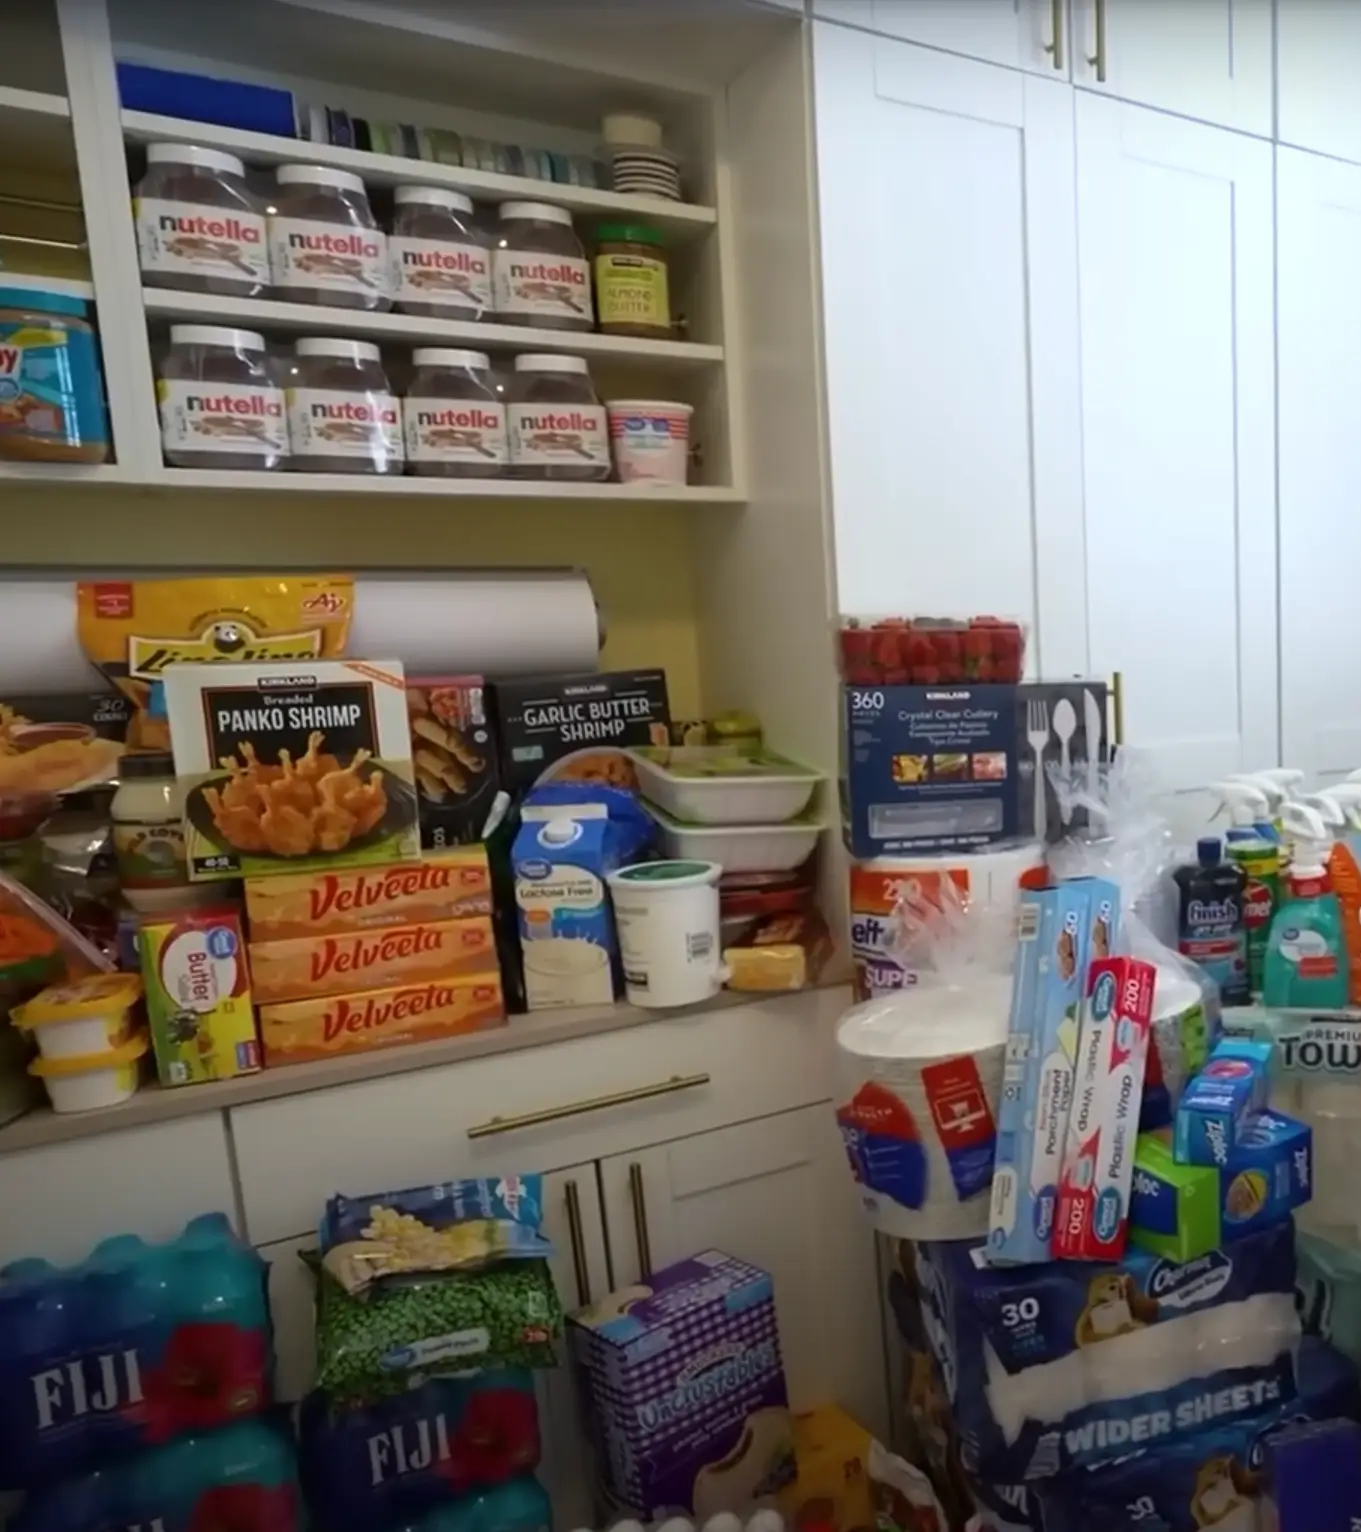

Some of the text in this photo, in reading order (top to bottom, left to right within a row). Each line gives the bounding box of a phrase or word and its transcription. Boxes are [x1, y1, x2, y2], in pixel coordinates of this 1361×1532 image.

[159, 213, 261, 244] nutella
[288, 230, 379, 259] nutella
[402, 249, 485, 275] nutella
[510, 262, 586, 285] nutella
[186, 394, 282, 418] nutella
[310, 402, 397, 425] nutela
[418, 409, 499, 430] nutella
[520, 412, 597, 432] nutella
[523, 697, 651, 727] GARLIC BUTTER
[851, 691, 885, 710] 360
[217, 704, 362, 733] PANKO SHRIMP
[561, 720, 626, 743] SHRIMP
[310, 863, 450, 921] Velveeta
[566, 885, 594, 897] Free
[1189, 900, 1238, 924] finish
[310, 926, 444, 982] Velveeta
[187, 951, 211, 1002] Butter
[1123, 979, 1140, 1013] 200
[323, 984, 455, 1042] Velveeta
[1045, 1068, 1063, 1156] Parchment
[1116, 1074, 1133, 1120] Wrap
[1108, 1121, 1127, 1179] Plastic
[1205, 1118, 1228, 1166] Ziploc
[1069, 1198, 1085, 1235] 200
[1001, 1297, 1040, 1327] 30
[29, 1349, 145, 1430] FIJI
[637, 1340, 779, 1431] Uncrustables
[1064, 1377, 1283, 1455] WIDER SHEETS
[366, 1413, 452, 1486] FIJI
